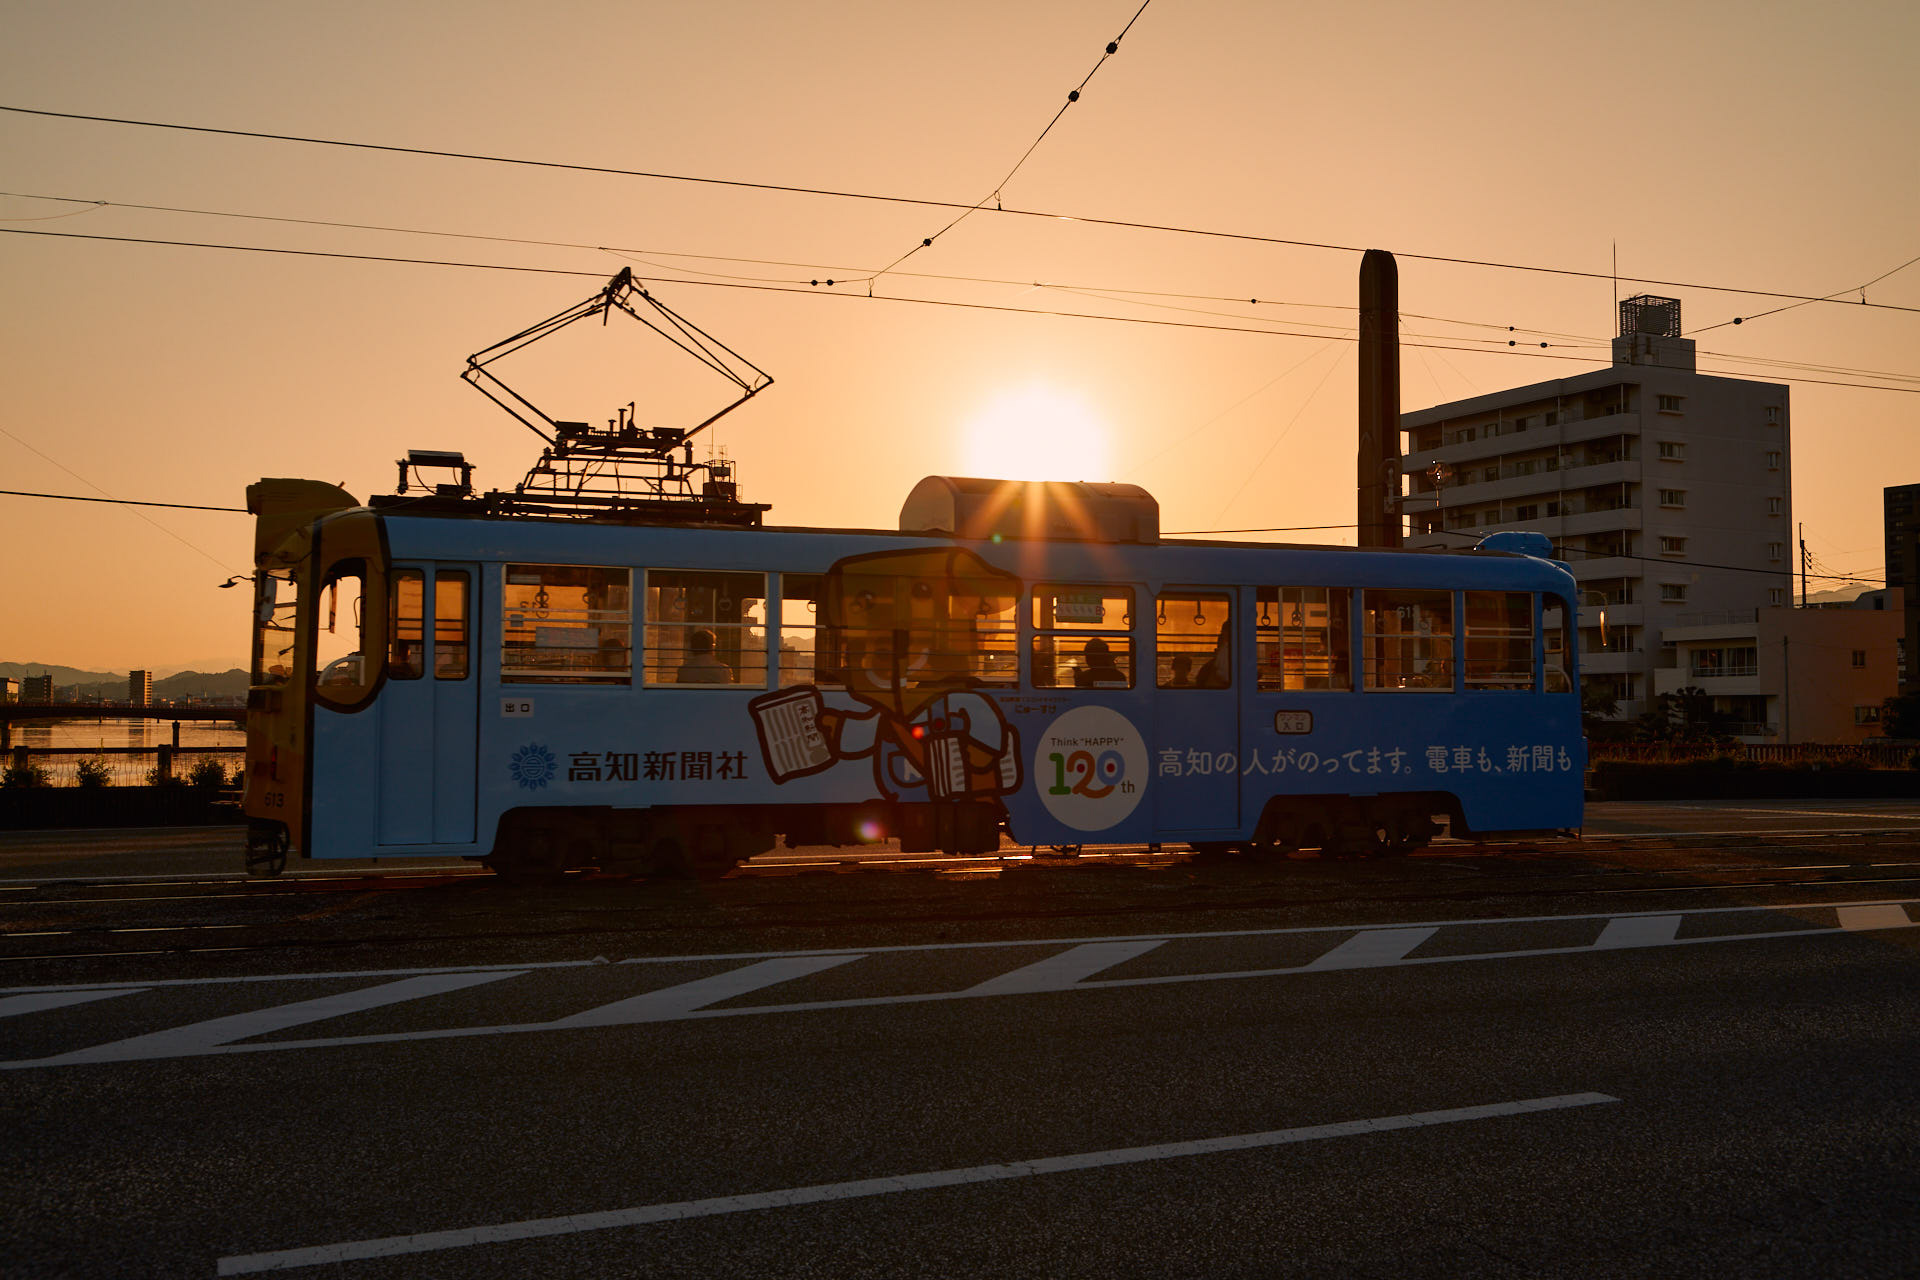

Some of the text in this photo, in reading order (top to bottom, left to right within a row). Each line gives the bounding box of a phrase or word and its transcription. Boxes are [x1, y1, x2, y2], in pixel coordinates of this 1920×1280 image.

[1396, 606, 1416, 619] 61
[505, 703, 530, 713] 出口
[1051, 737, 1079, 747] Think
[568, 751, 749, 782] 高知新聞社
[264, 792, 285, 809] 613
